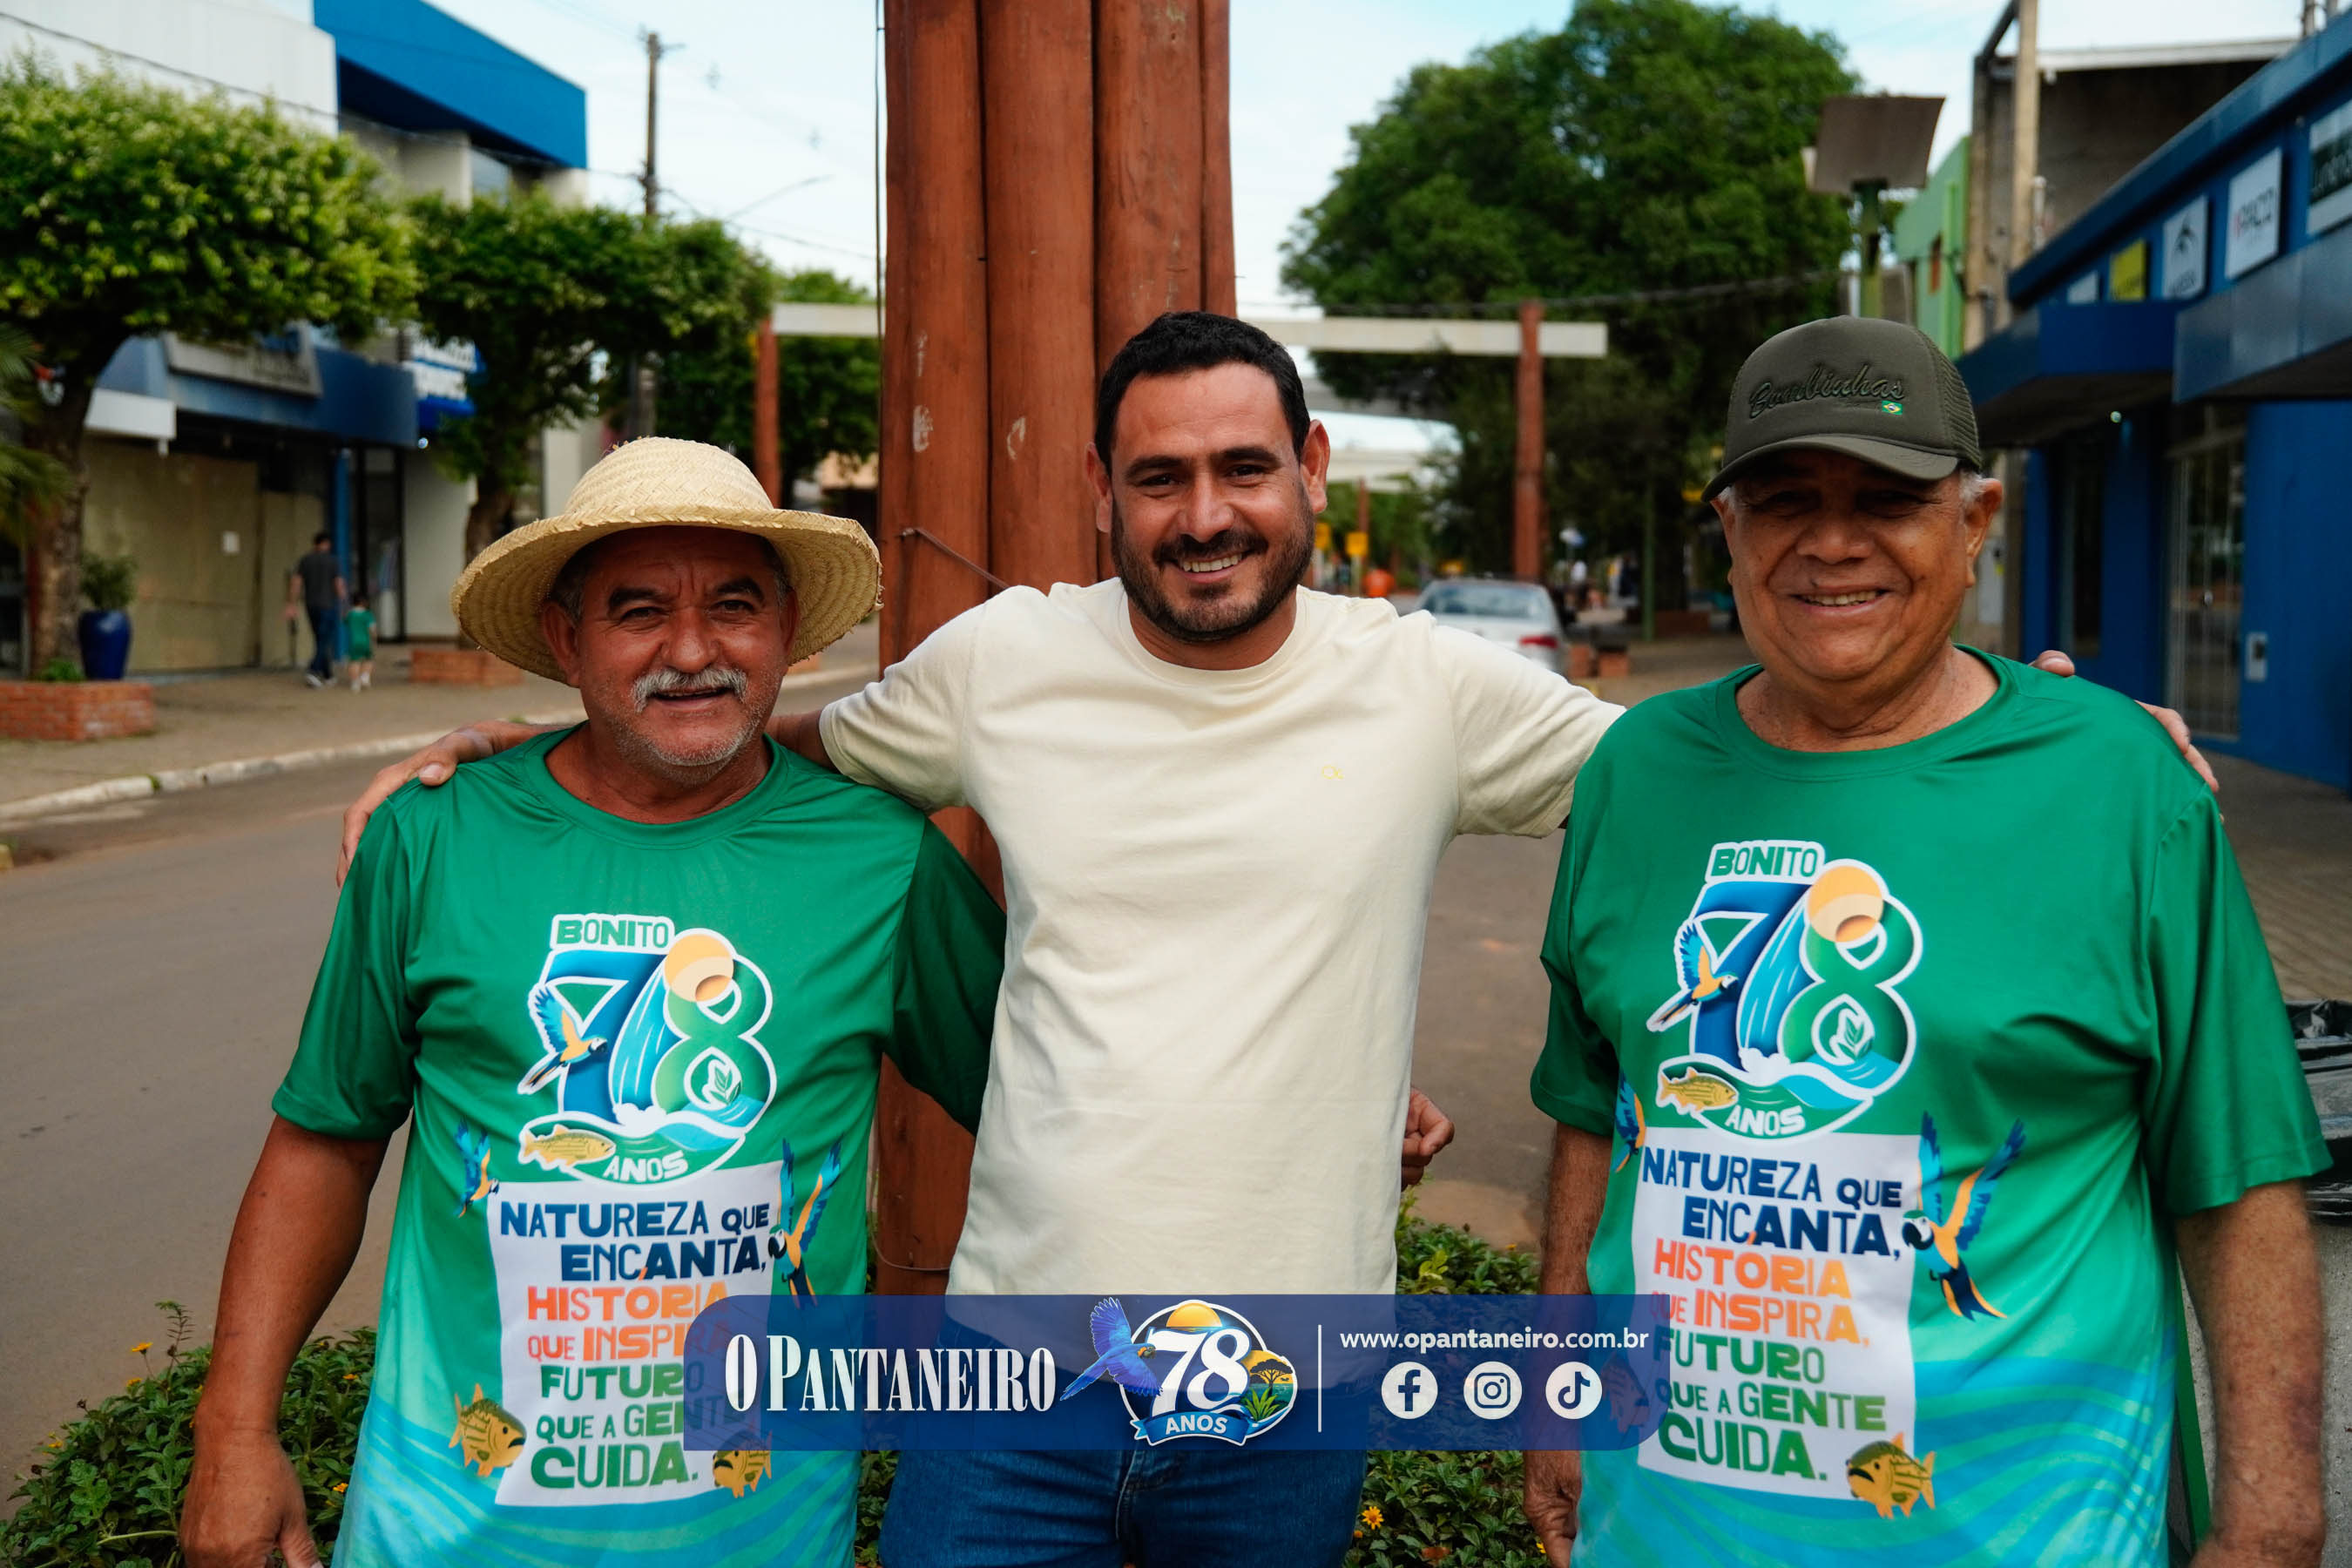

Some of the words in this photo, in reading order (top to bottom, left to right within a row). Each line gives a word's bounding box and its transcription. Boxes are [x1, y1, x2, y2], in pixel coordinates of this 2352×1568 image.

[1711, 846, 1819, 877] BONITO
[556, 918, 669, 949] BONITO
[1693, 865, 1916, 1073] 78
[542, 935, 775, 1127] 78
[1725, 1105, 1806, 1137] ANOS
[602, 1149, 689, 1181] ANOS
[1642, 1146, 1822, 1202] NATUREZA
[1836, 1177, 1903, 1208] QUE
[500, 1200, 710, 1238] NATUREZA
[720, 1203, 770, 1232] QUE
[1681, 1195, 1901, 1262] ENCANTA,
[560, 1233, 767, 1281] ENCANTA,
[1652, 1231, 1853, 1299] HISTÓRIA
[527, 1267, 730, 1321] HISTÓRIA
[1649, 1290, 1688, 1324] QUE
[1693, 1288, 1870, 1348] INSPIRA,
[528, 1335, 575, 1362] QUE
[1652, 1324, 1825, 1383] FUTURO
[540, 1360, 705, 1401] FUTURO
[1656, 1377, 1709, 1411] QUE
[1718, 1389, 1732, 1414] A
[1738, 1381, 1886, 1432] GENTE
[536, 1415, 594, 1443] QUE
[606, 1416, 617, 1438] A
[1658, 1411, 1828, 1481] CUIDA.
[531, 1440, 699, 1490] CUIDA.
